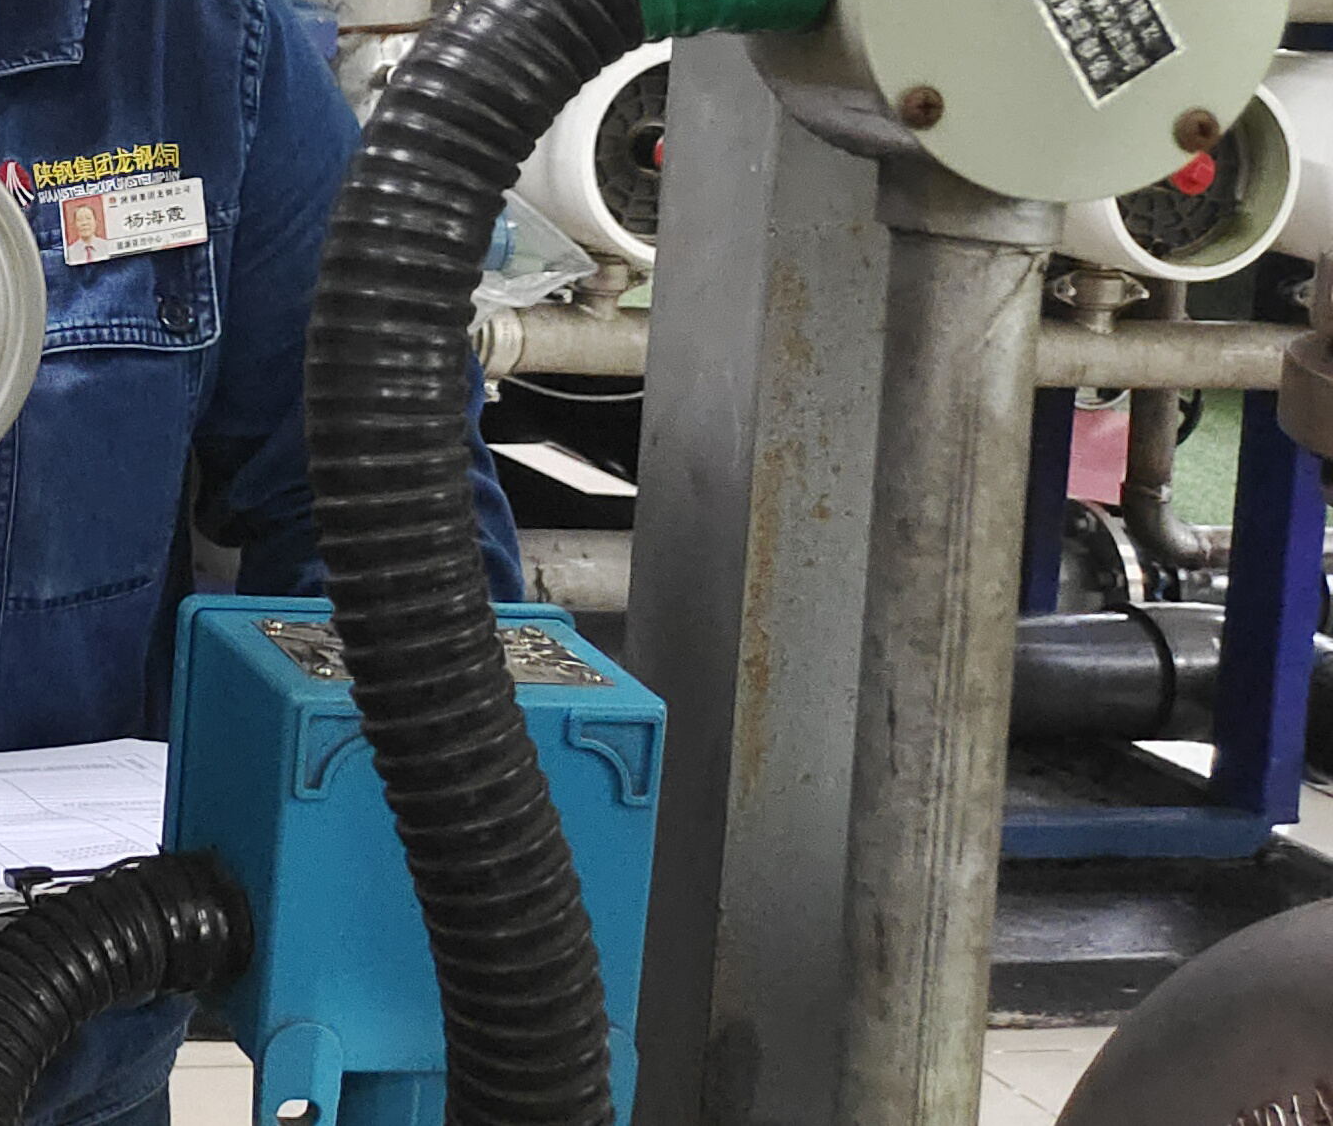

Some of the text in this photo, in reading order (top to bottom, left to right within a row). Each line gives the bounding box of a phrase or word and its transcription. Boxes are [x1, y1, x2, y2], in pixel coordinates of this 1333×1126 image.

[33, 143, 180, 189] 陕钢集团龙钢公司
[123, 205, 186, 229] 杨海霞
